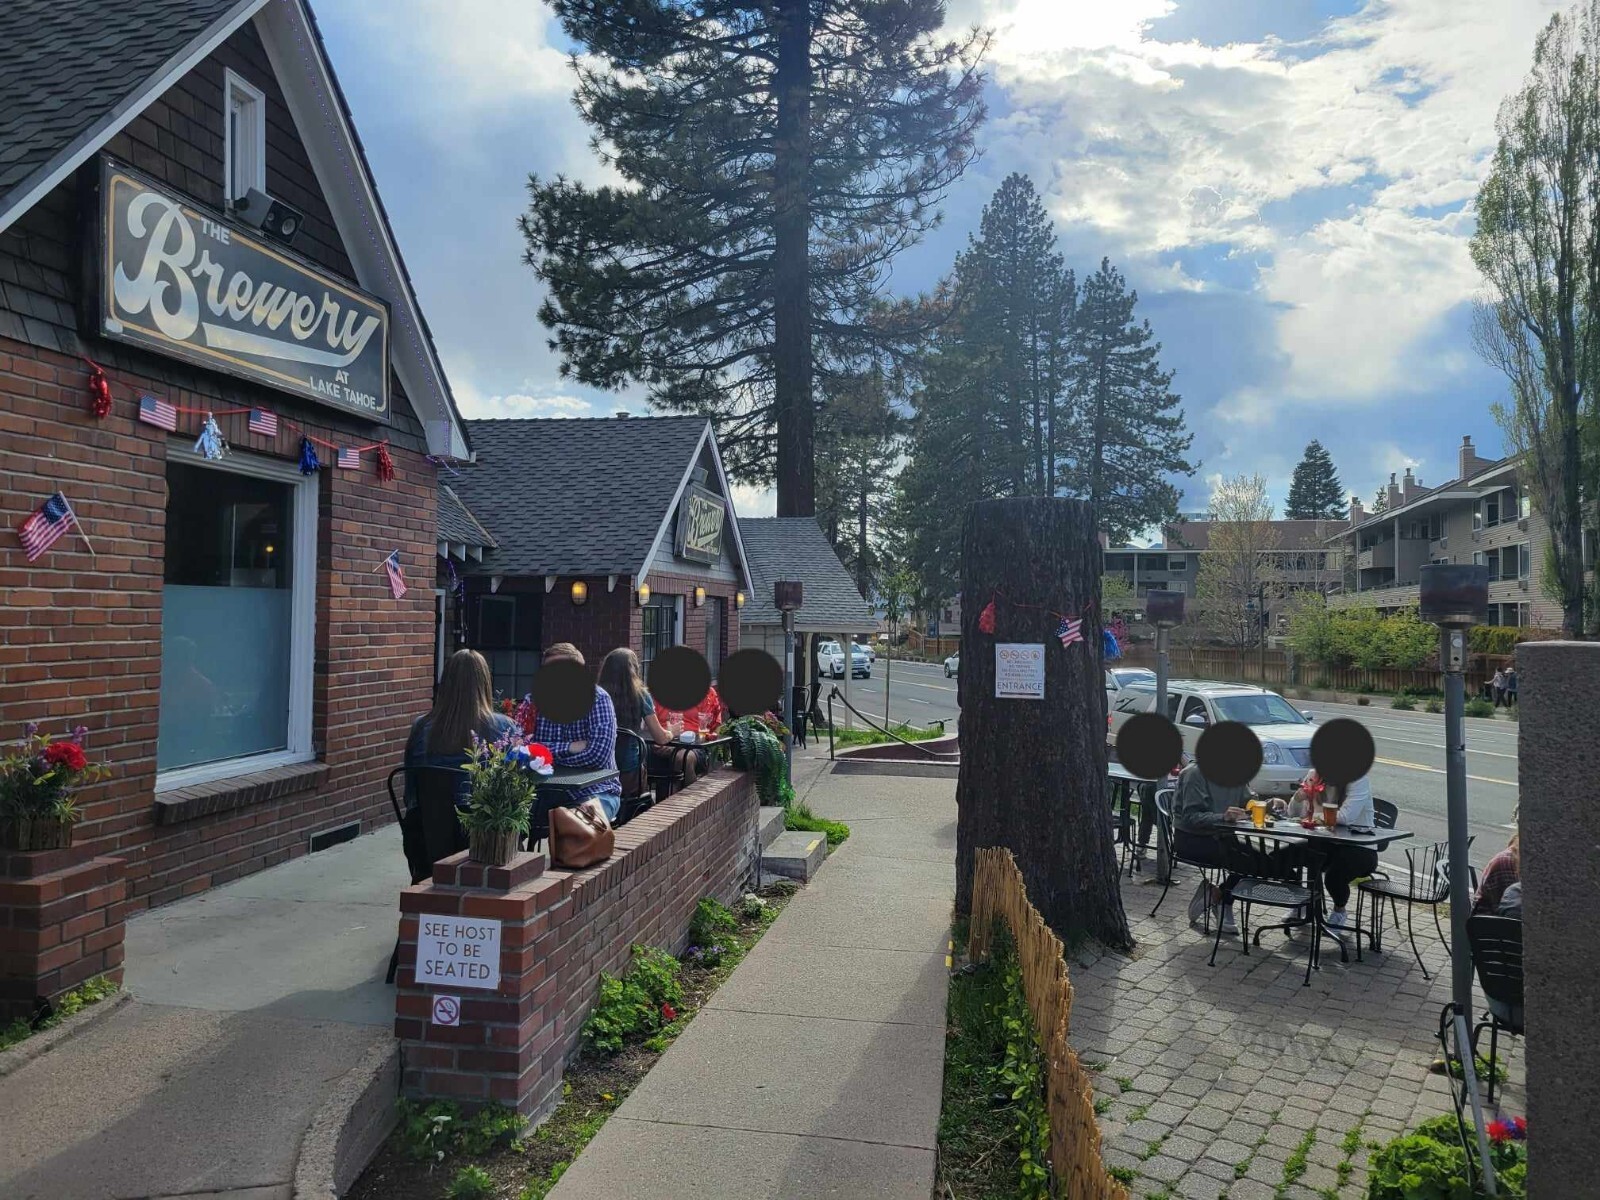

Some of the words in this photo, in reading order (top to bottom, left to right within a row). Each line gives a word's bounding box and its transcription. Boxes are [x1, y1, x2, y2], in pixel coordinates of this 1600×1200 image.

[200, 217, 231, 245] THE
[113, 192, 381, 367] Brewery
[334, 370, 350, 385] AT
[309, 377, 341, 399] LAKE
[343, 388, 377, 409] TAHOE
[997, 682, 1042, 690] ENTRANCE
[424, 922, 450, 937] SEE
[455, 925, 496, 941] HOST
[436, 941, 458, 956] TO
[463, 943, 481, 957] BE
[424, 960, 490, 979] SEATED
